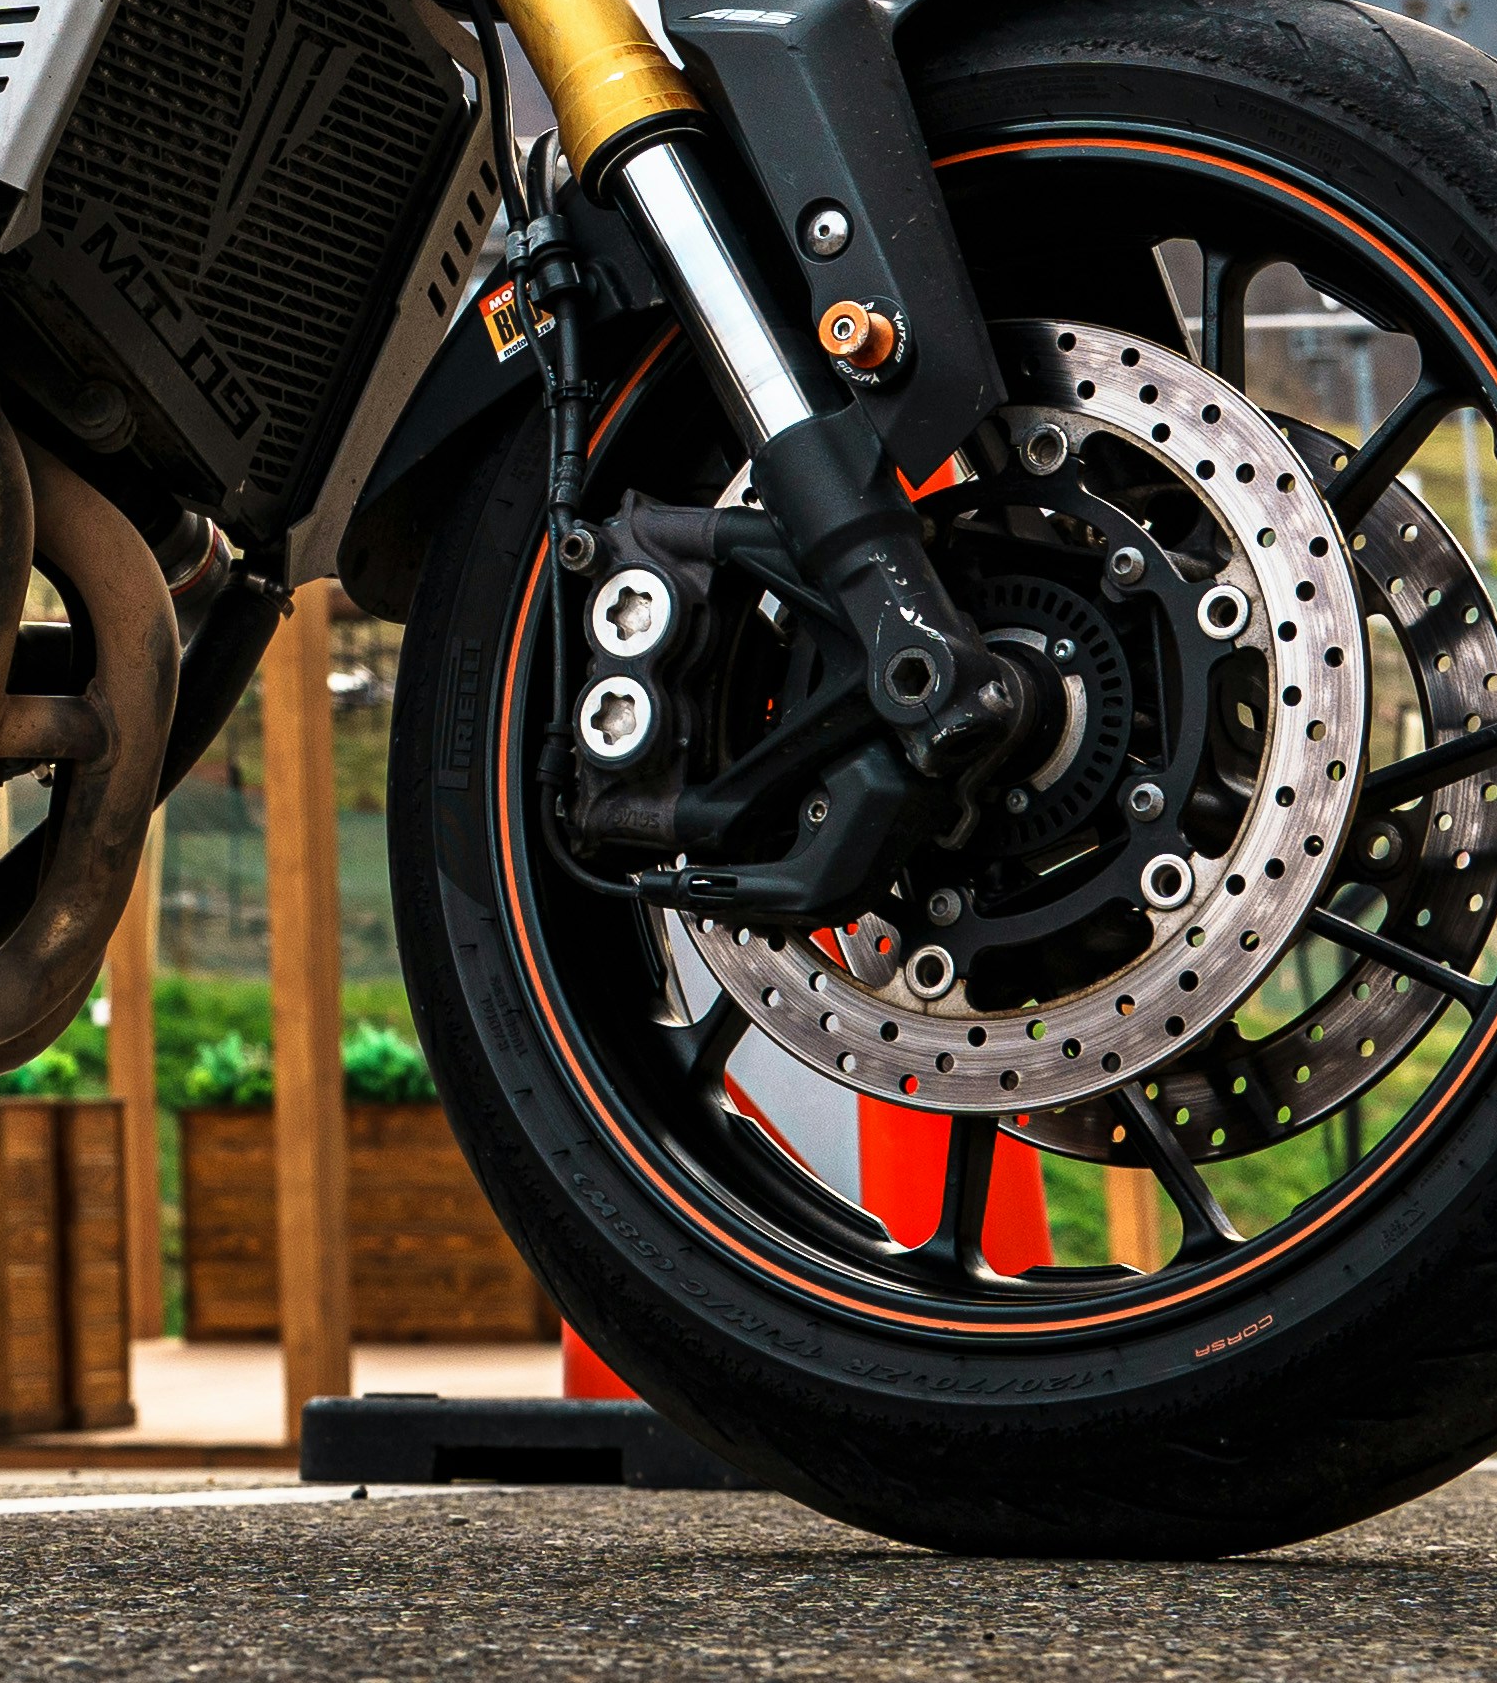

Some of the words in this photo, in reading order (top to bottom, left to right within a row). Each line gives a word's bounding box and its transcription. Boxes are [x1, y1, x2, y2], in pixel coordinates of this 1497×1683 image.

[681, 8, 804, 28] ABS
[1236, 100, 1288, 129] FRONT
[1295, 120, 1348, 154] WHEEL
[1267, 127, 1344, 170] ROTATION
[439, 636, 484, 793] PIRELLI
[1193, 1314, 1274, 1359] CORSA
[926, 1370, 1094, 1395] 120/70
